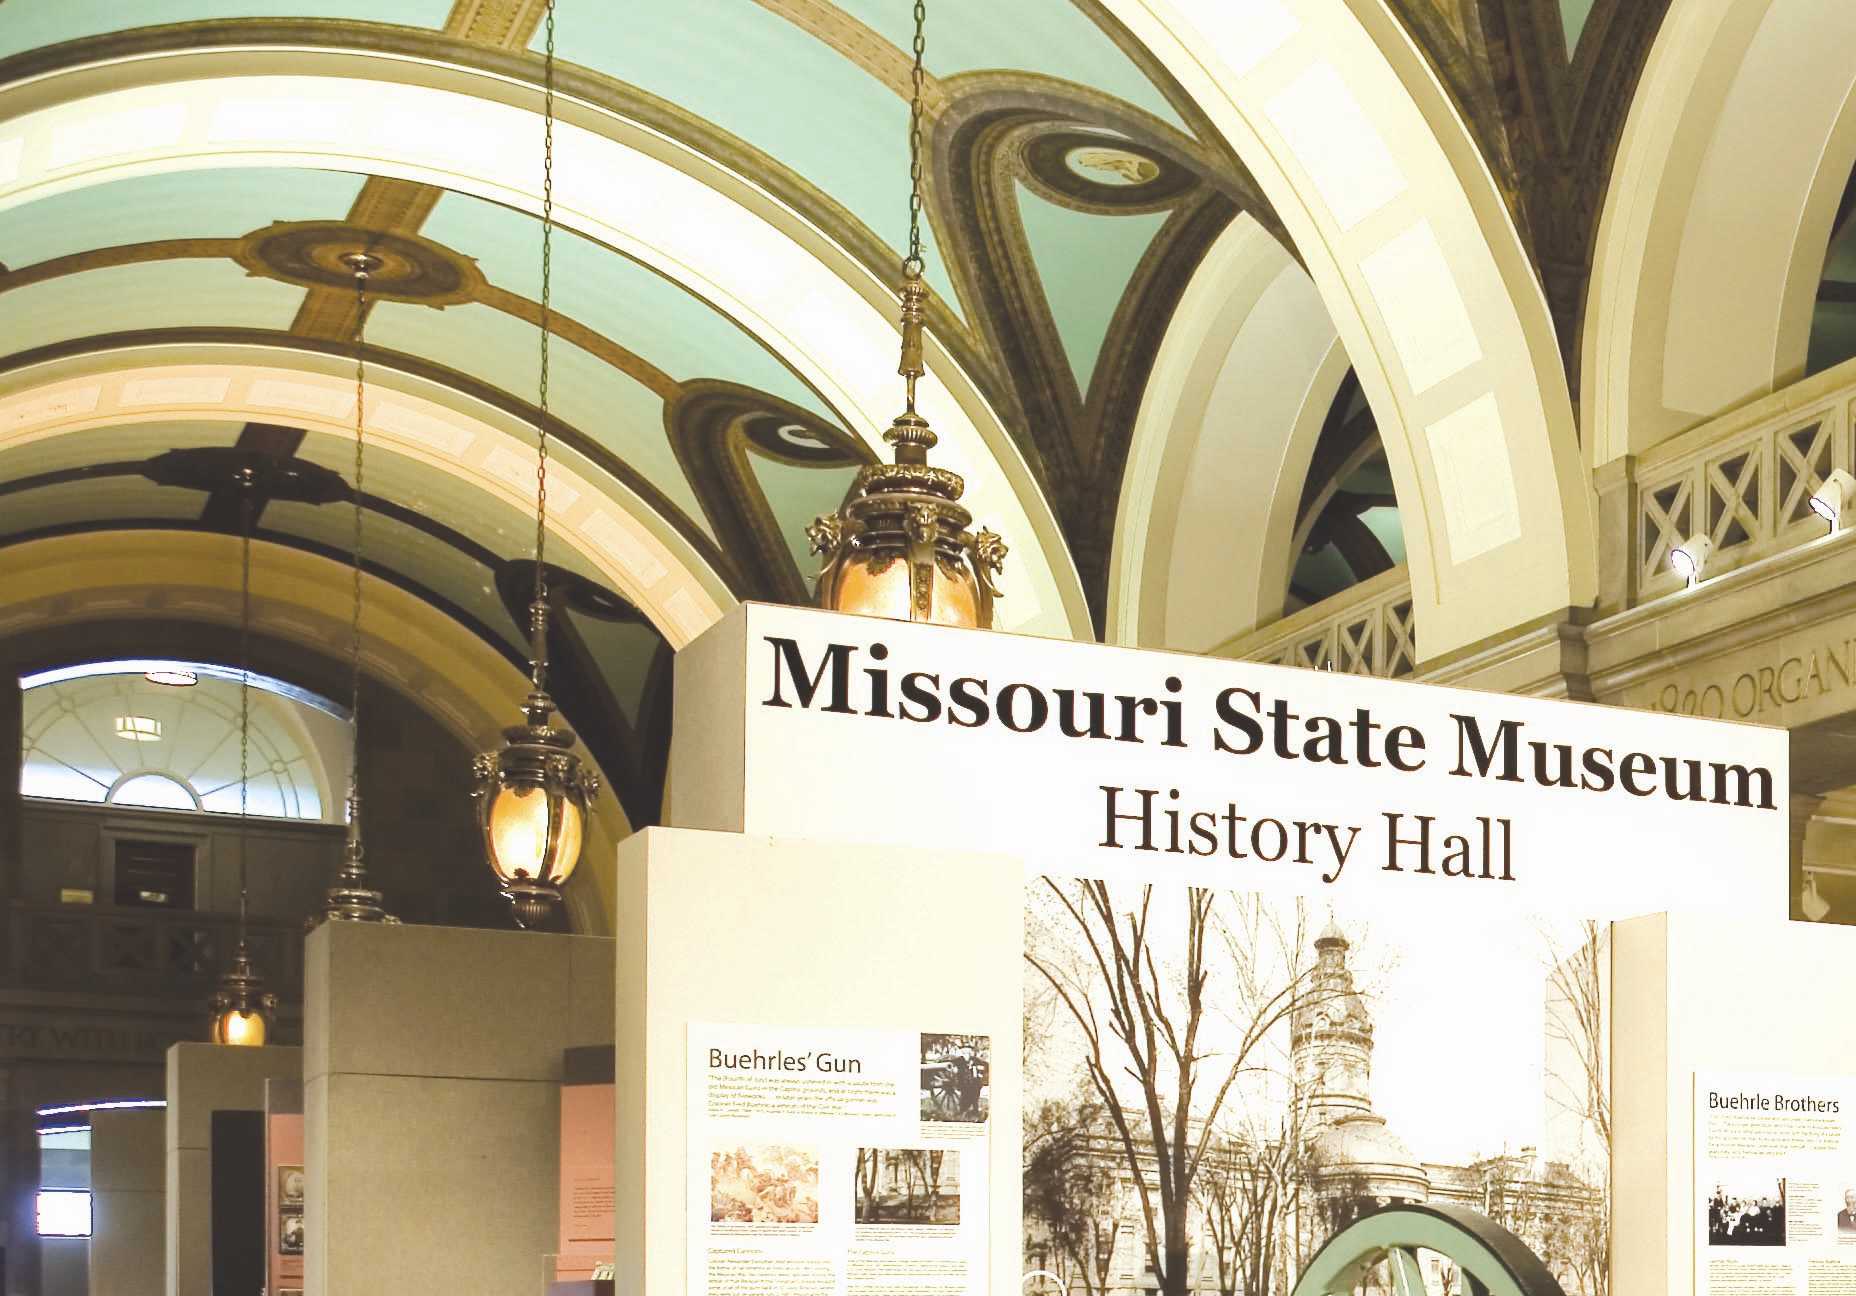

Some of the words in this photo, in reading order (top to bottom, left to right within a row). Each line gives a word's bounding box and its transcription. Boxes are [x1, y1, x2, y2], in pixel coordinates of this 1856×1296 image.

[762, 636, 1188, 748] Missouri
[1213, 687, 1426, 772] State
[1448, 713, 1778, 811] Museum
[1098, 785, 1362, 877] History
[1381, 812, 1516, 881] Hall
[816, 1052, 861, 1073] Gun
[1709, 1091, 1770, 1111] Buehrle
[1774, 1094, 1839, 1113] Brothers
